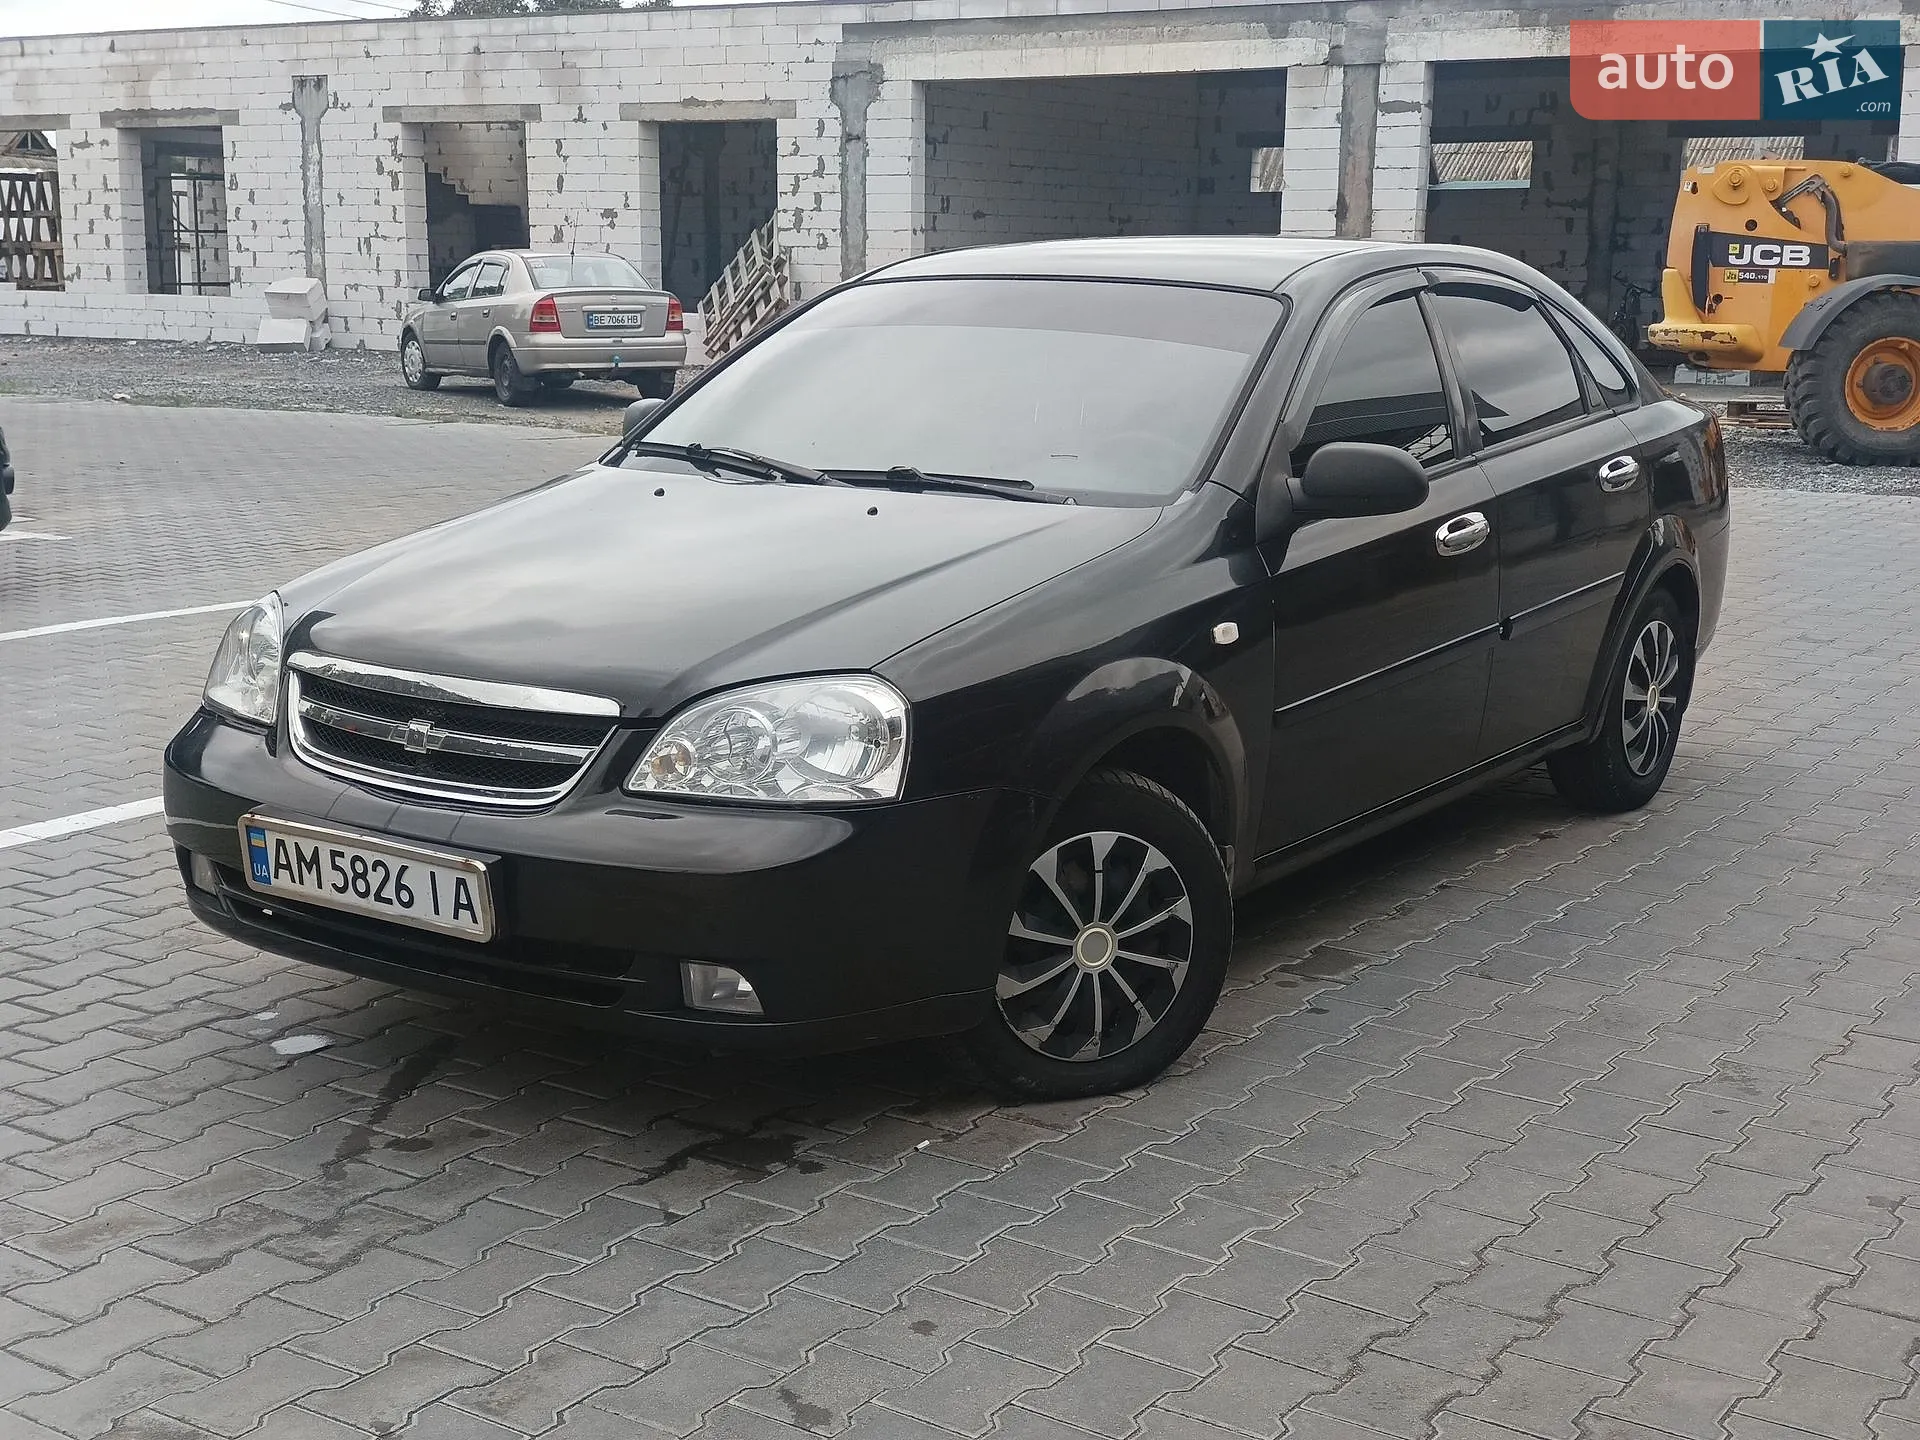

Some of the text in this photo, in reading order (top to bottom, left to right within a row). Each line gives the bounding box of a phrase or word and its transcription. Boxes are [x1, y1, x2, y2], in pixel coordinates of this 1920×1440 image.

[1728, 244, 1811, 266] JCB
[593, 315, 638, 325] BE 7066 HB
[253, 863, 269, 879] UA
[273, 838, 323, 890] AM
[329, 849, 415, 909] 5826
